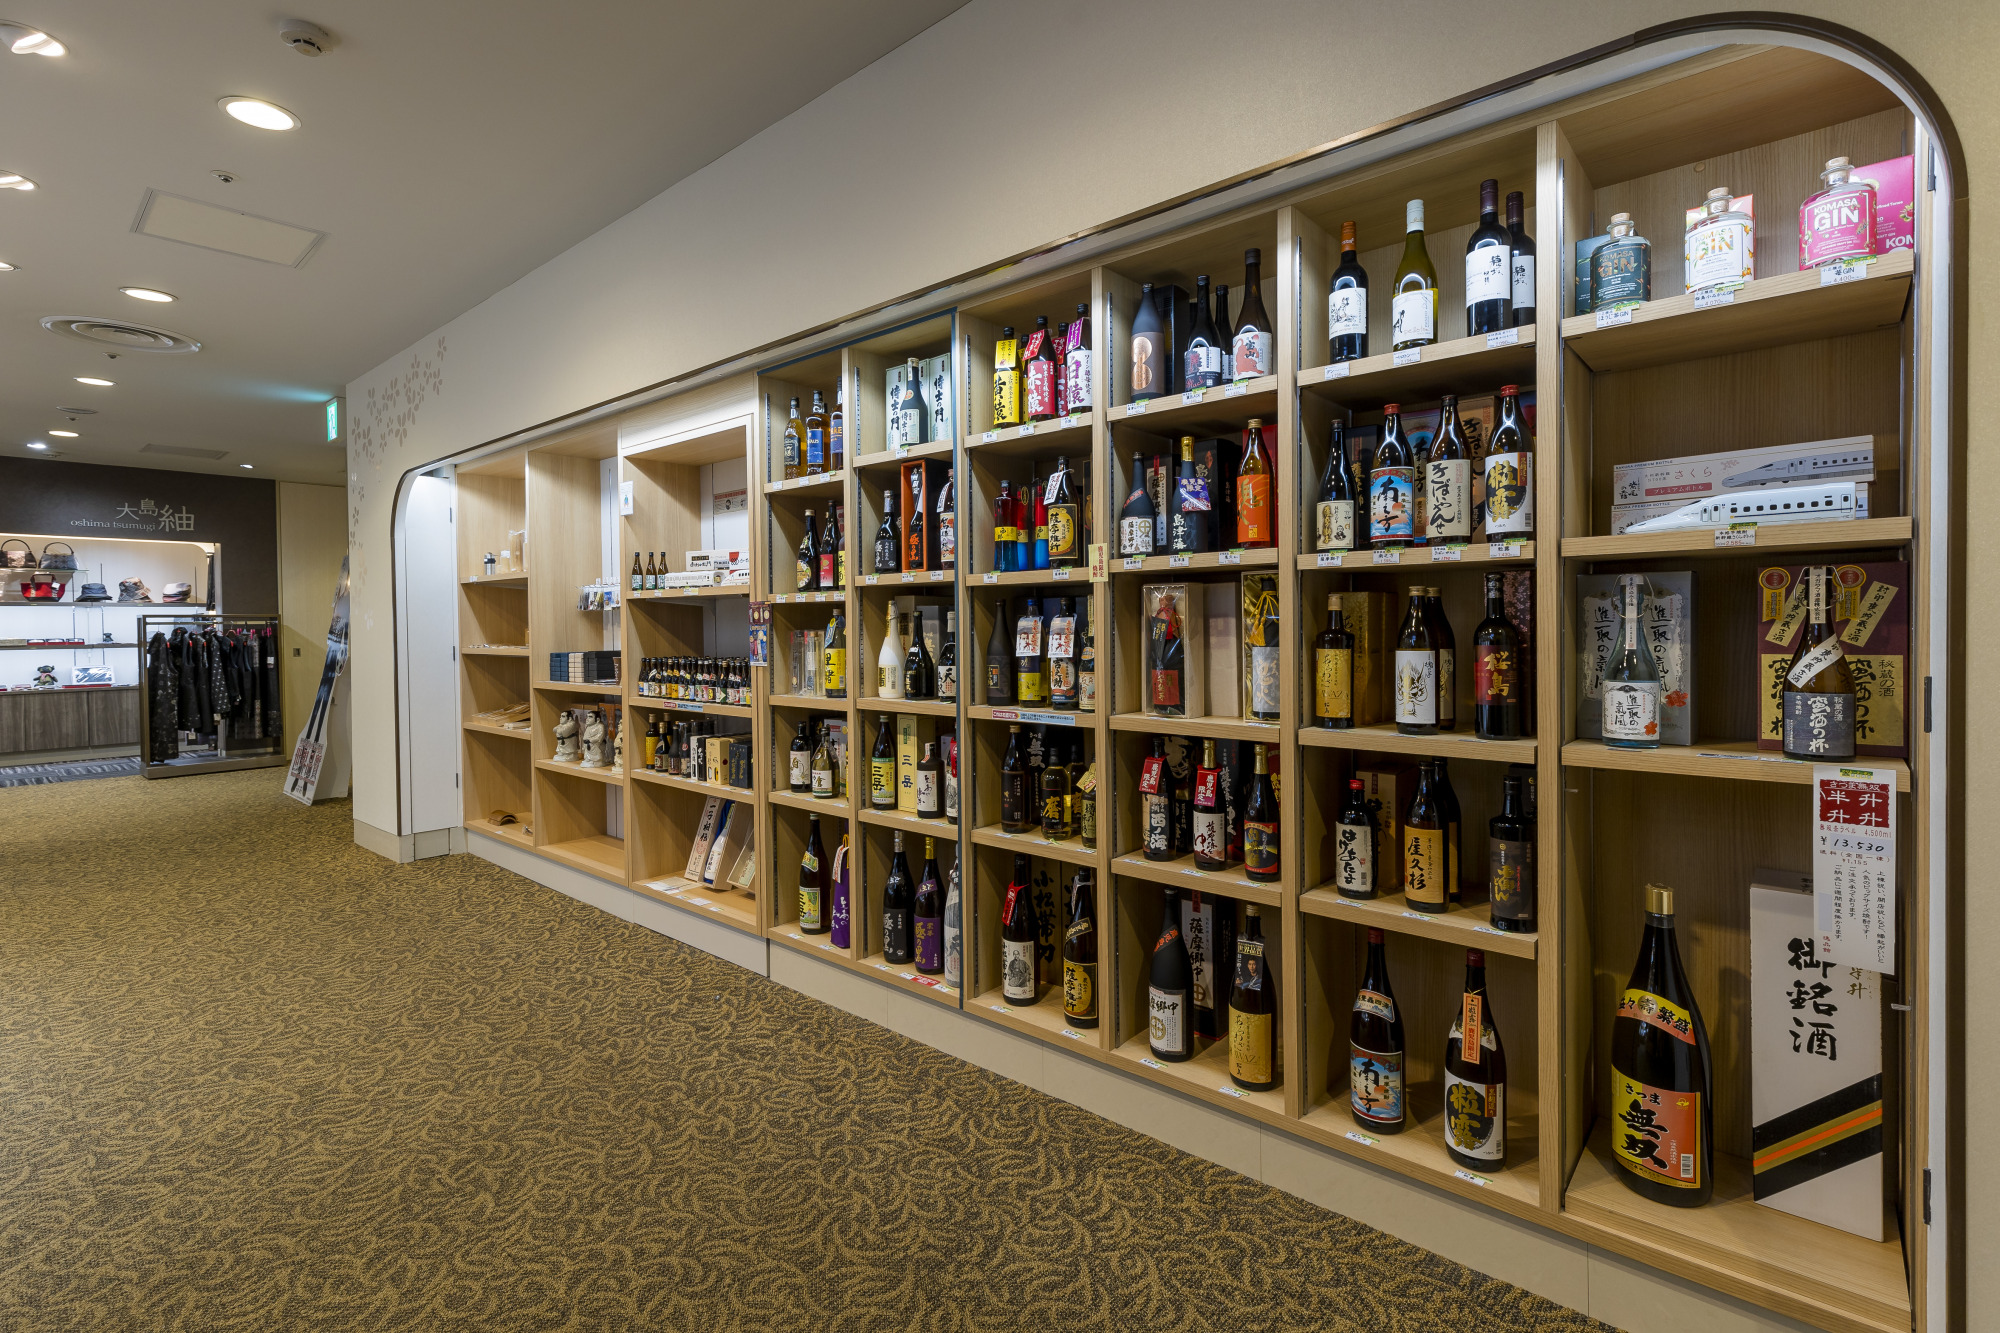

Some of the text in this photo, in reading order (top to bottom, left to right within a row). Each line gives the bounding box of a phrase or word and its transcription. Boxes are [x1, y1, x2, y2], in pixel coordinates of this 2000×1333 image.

[1814, 197, 1858, 219] KOMASA
[1814, 206, 1859, 231] GIN
[1694, 234, 1734, 261] GIN
[1695, 227, 1733, 243] KOMASA
[1600, 249, 1634, 262] KOMASA
[1600, 255, 1635, 278] GIN
[1634, 461, 1655, 469] PREMIUM
[1674, 465, 1712, 480] さくら
[1653, 484, 1705, 495] プレミアムボトル
[70, 518, 156, 531] oshima tsumugi
[116, 498, 195, 532] 大島紬
[1173, 513, 1187, 550] 島津藩
[1484, 651, 1512, 696] 桜島
[1878, 659, 1896, 697] 秘蔵の酒
[1795, 694, 1803, 715] 本格焼酎
[1833, 696, 1844, 722] 秘蔵の酒
[902, 755, 914, 788] 三岳
[1828, 779, 1880, 792] さつま無双
[1407, 837, 1428, 890] 屋久杉
[1188, 916, 1206, 982] 薩摩郷中
[1785, 937, 1838, 1061] 御銘酒
[1655, 1005, 1692, 1035] 繁盛
[1625, 1082, 1662, 1106] さつま
